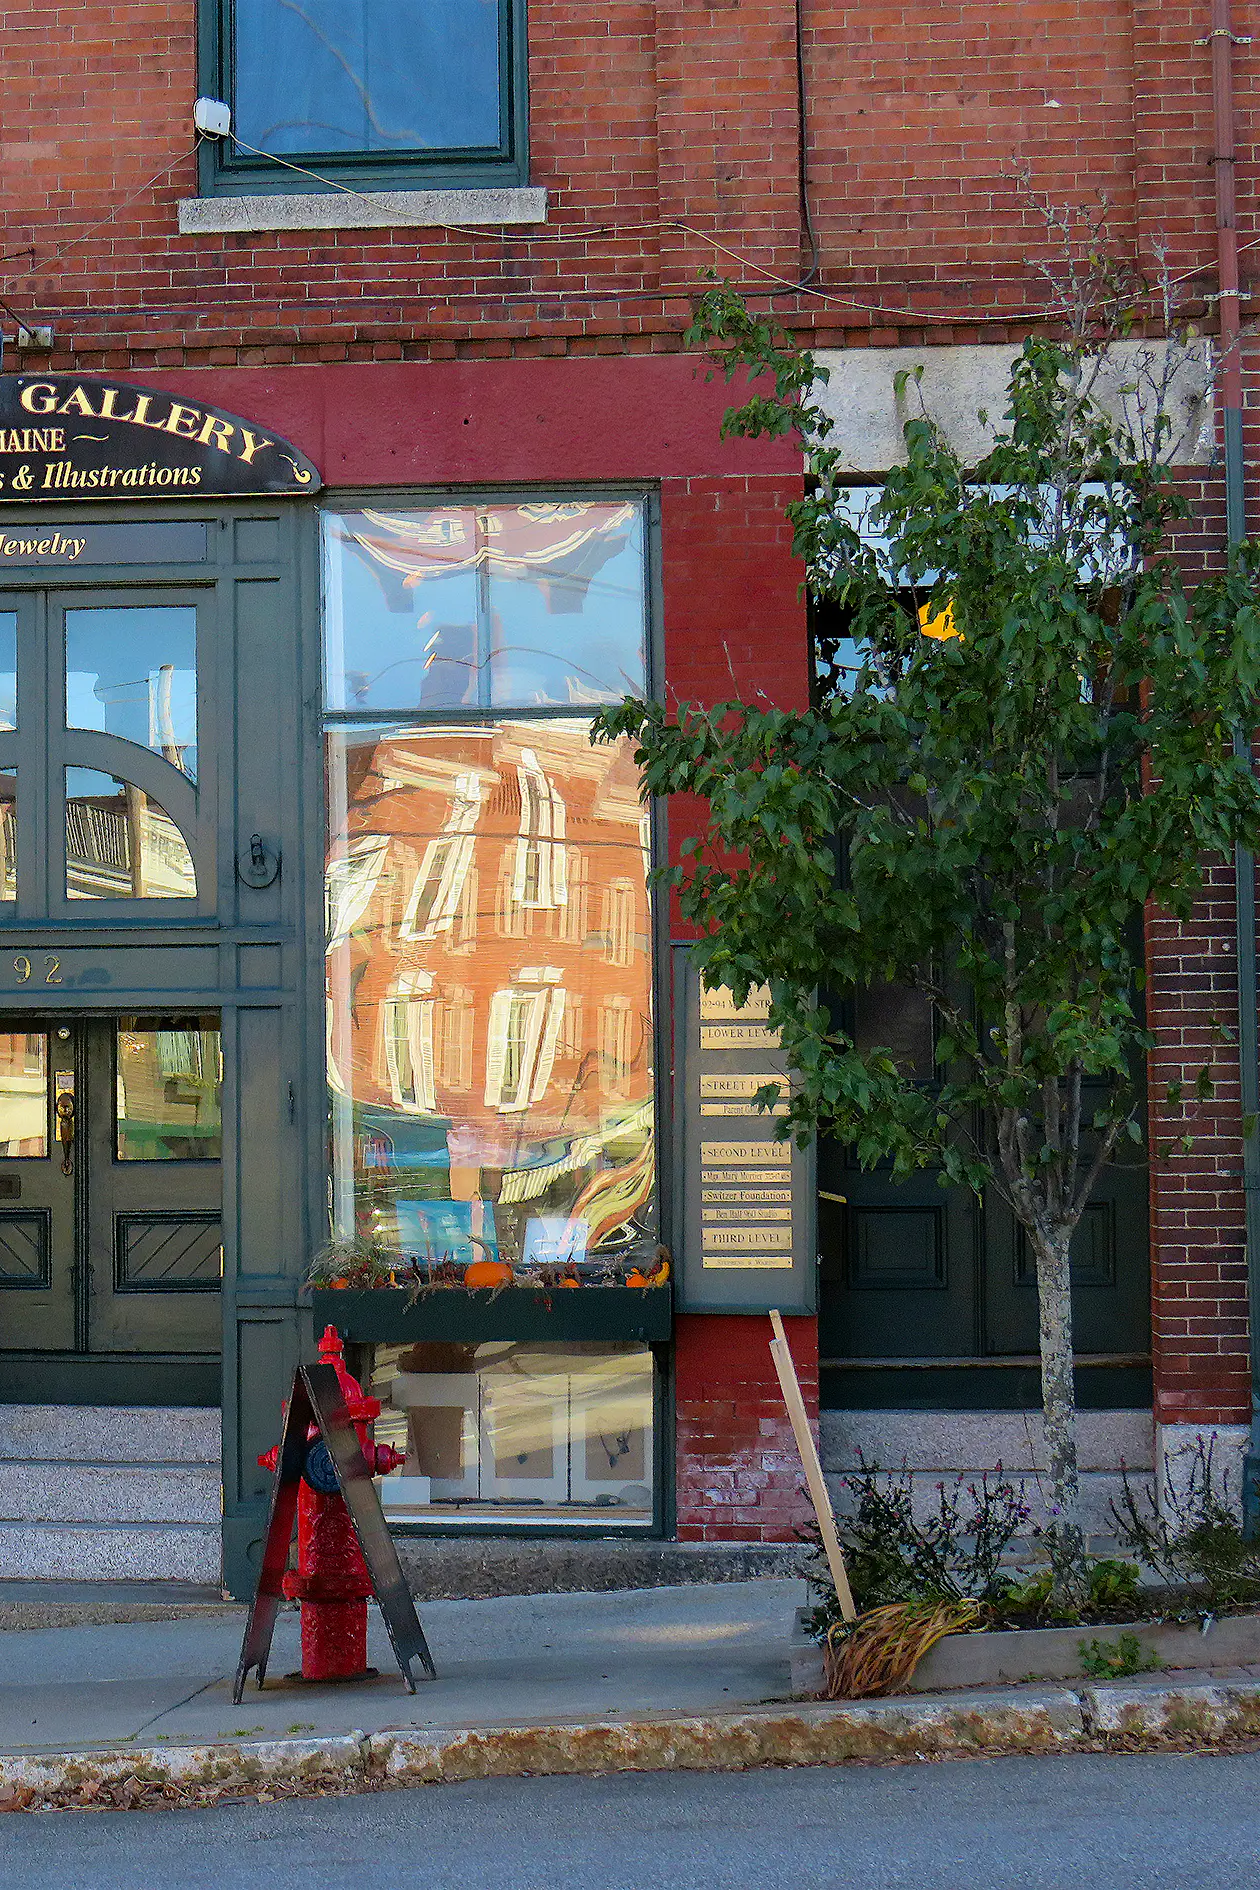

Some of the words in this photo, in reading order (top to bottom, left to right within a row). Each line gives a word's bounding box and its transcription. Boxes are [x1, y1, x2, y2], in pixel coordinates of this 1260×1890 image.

[18, 382, 276, 466] GALLERY
[12, 463, 34, 490] &
[42, 461, 202, 490] Illustrations
[12, 955, 63, 985] 92
[707, 1029, 744, 1039] LOWER
[706, 1080, 746, 1090] STREET
[707, 1148, 747, 1157] SECOND
[751, 1147, 784, 1157] LEVEL
[707, 1191, 737, 1200] Switzer
[740, 1191, 786, 1200] Foundation
[712, 1234, 745, 1243] THIRD
[748, 1234, 782, 1243] LEVEL
